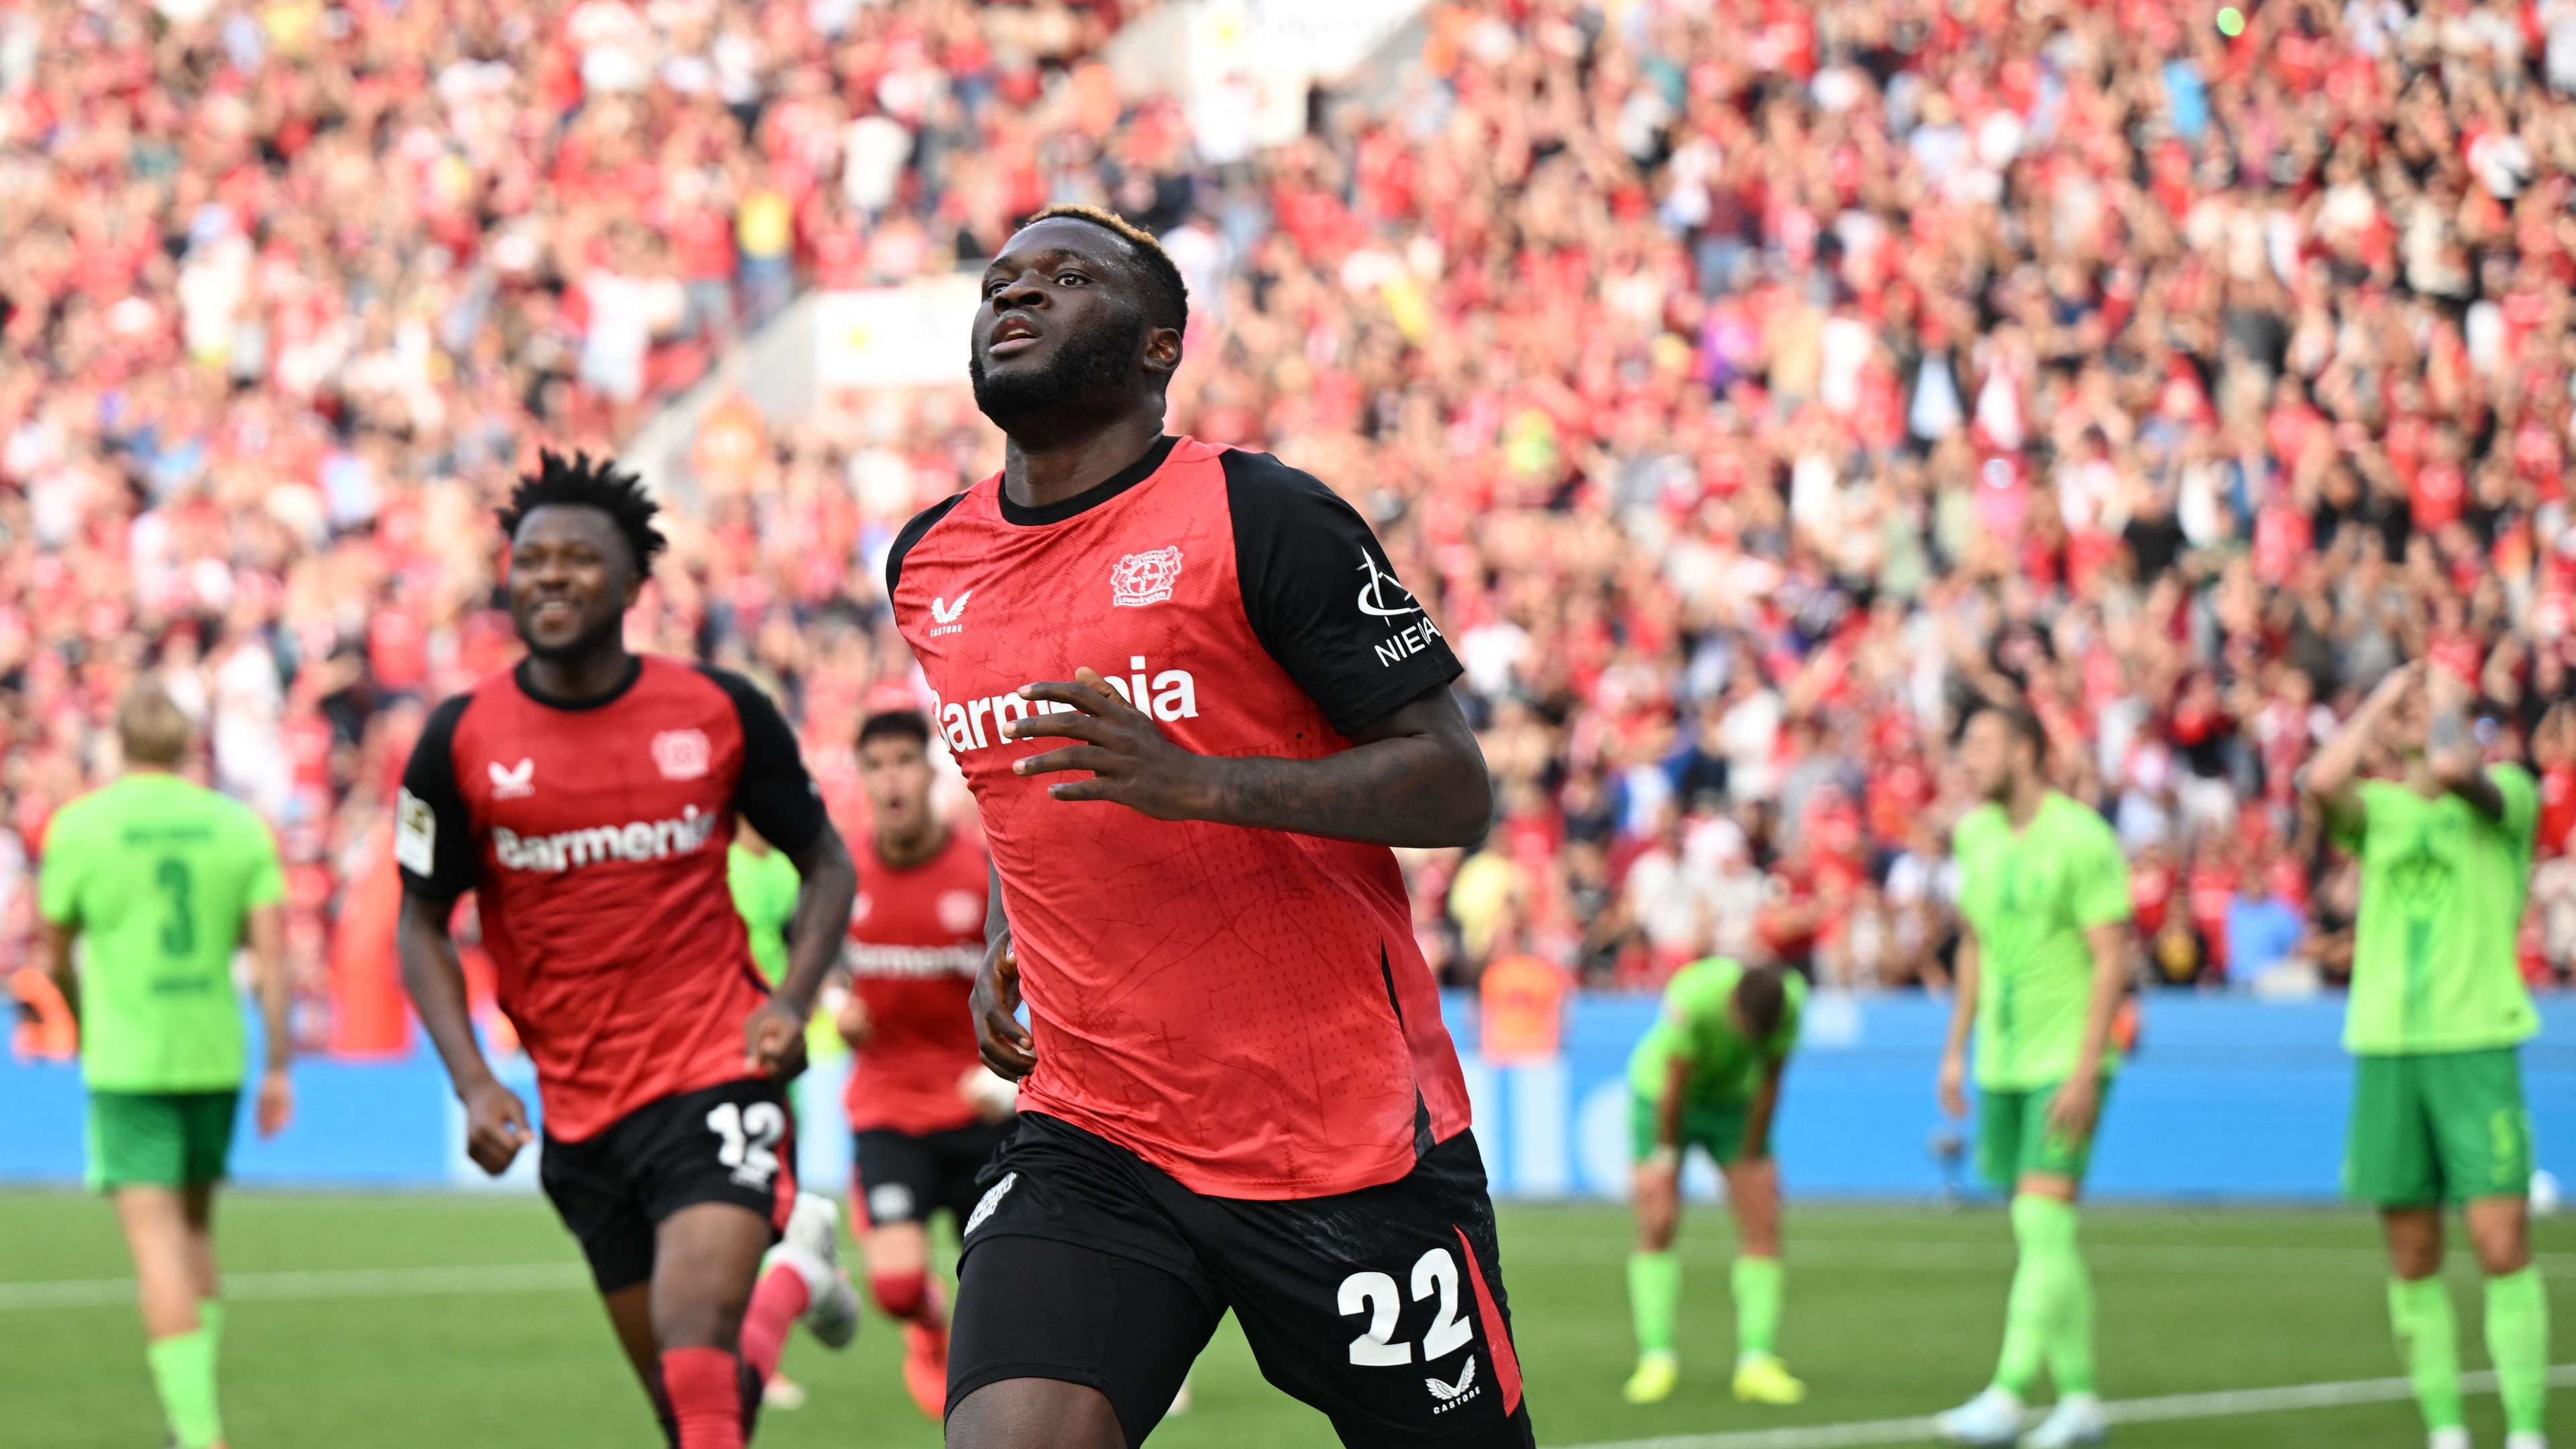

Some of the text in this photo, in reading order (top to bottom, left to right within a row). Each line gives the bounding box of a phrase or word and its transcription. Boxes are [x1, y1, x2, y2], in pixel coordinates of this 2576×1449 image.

[930, 624, 963, 637] CASTORE
[156, 857, 195, 956] 3
[706, 1102, 785, 1171] 12
[1338, 1248, 1474, 1366] 22
[1433, 1386, 1481, 1415] CASTORE
